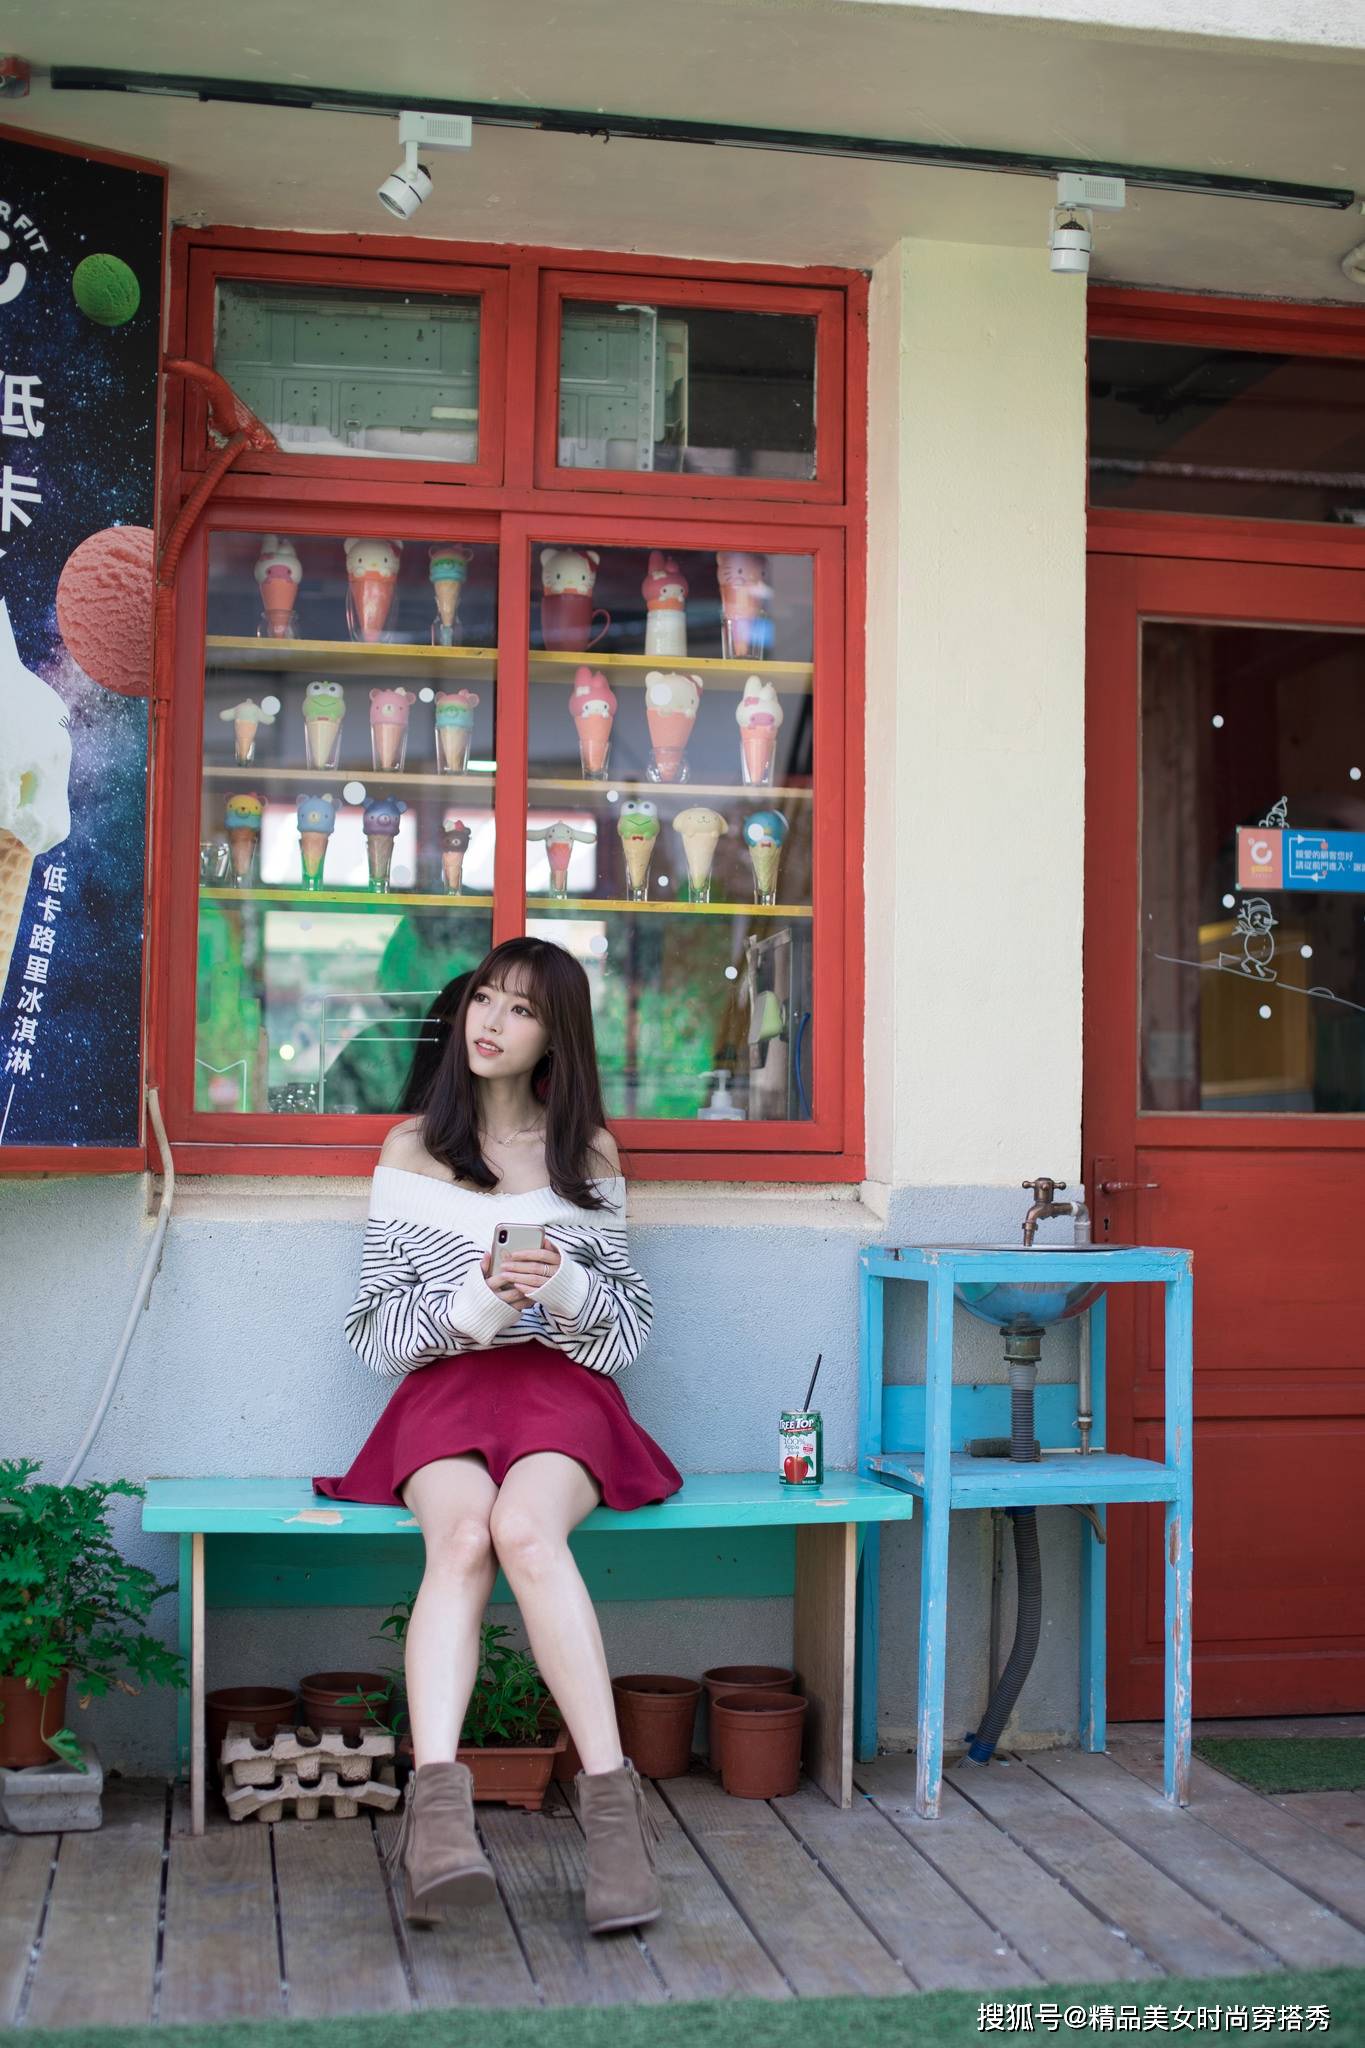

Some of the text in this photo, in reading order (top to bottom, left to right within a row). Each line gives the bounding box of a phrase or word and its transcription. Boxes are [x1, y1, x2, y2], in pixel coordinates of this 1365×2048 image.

[13, 214, 49, 253] FIT
[0, 369, 46, 558] 低卡
[5, 864, 67, 1076] 低卡路里冰淇淋
[796, 1418, 815, 1428] TOP
